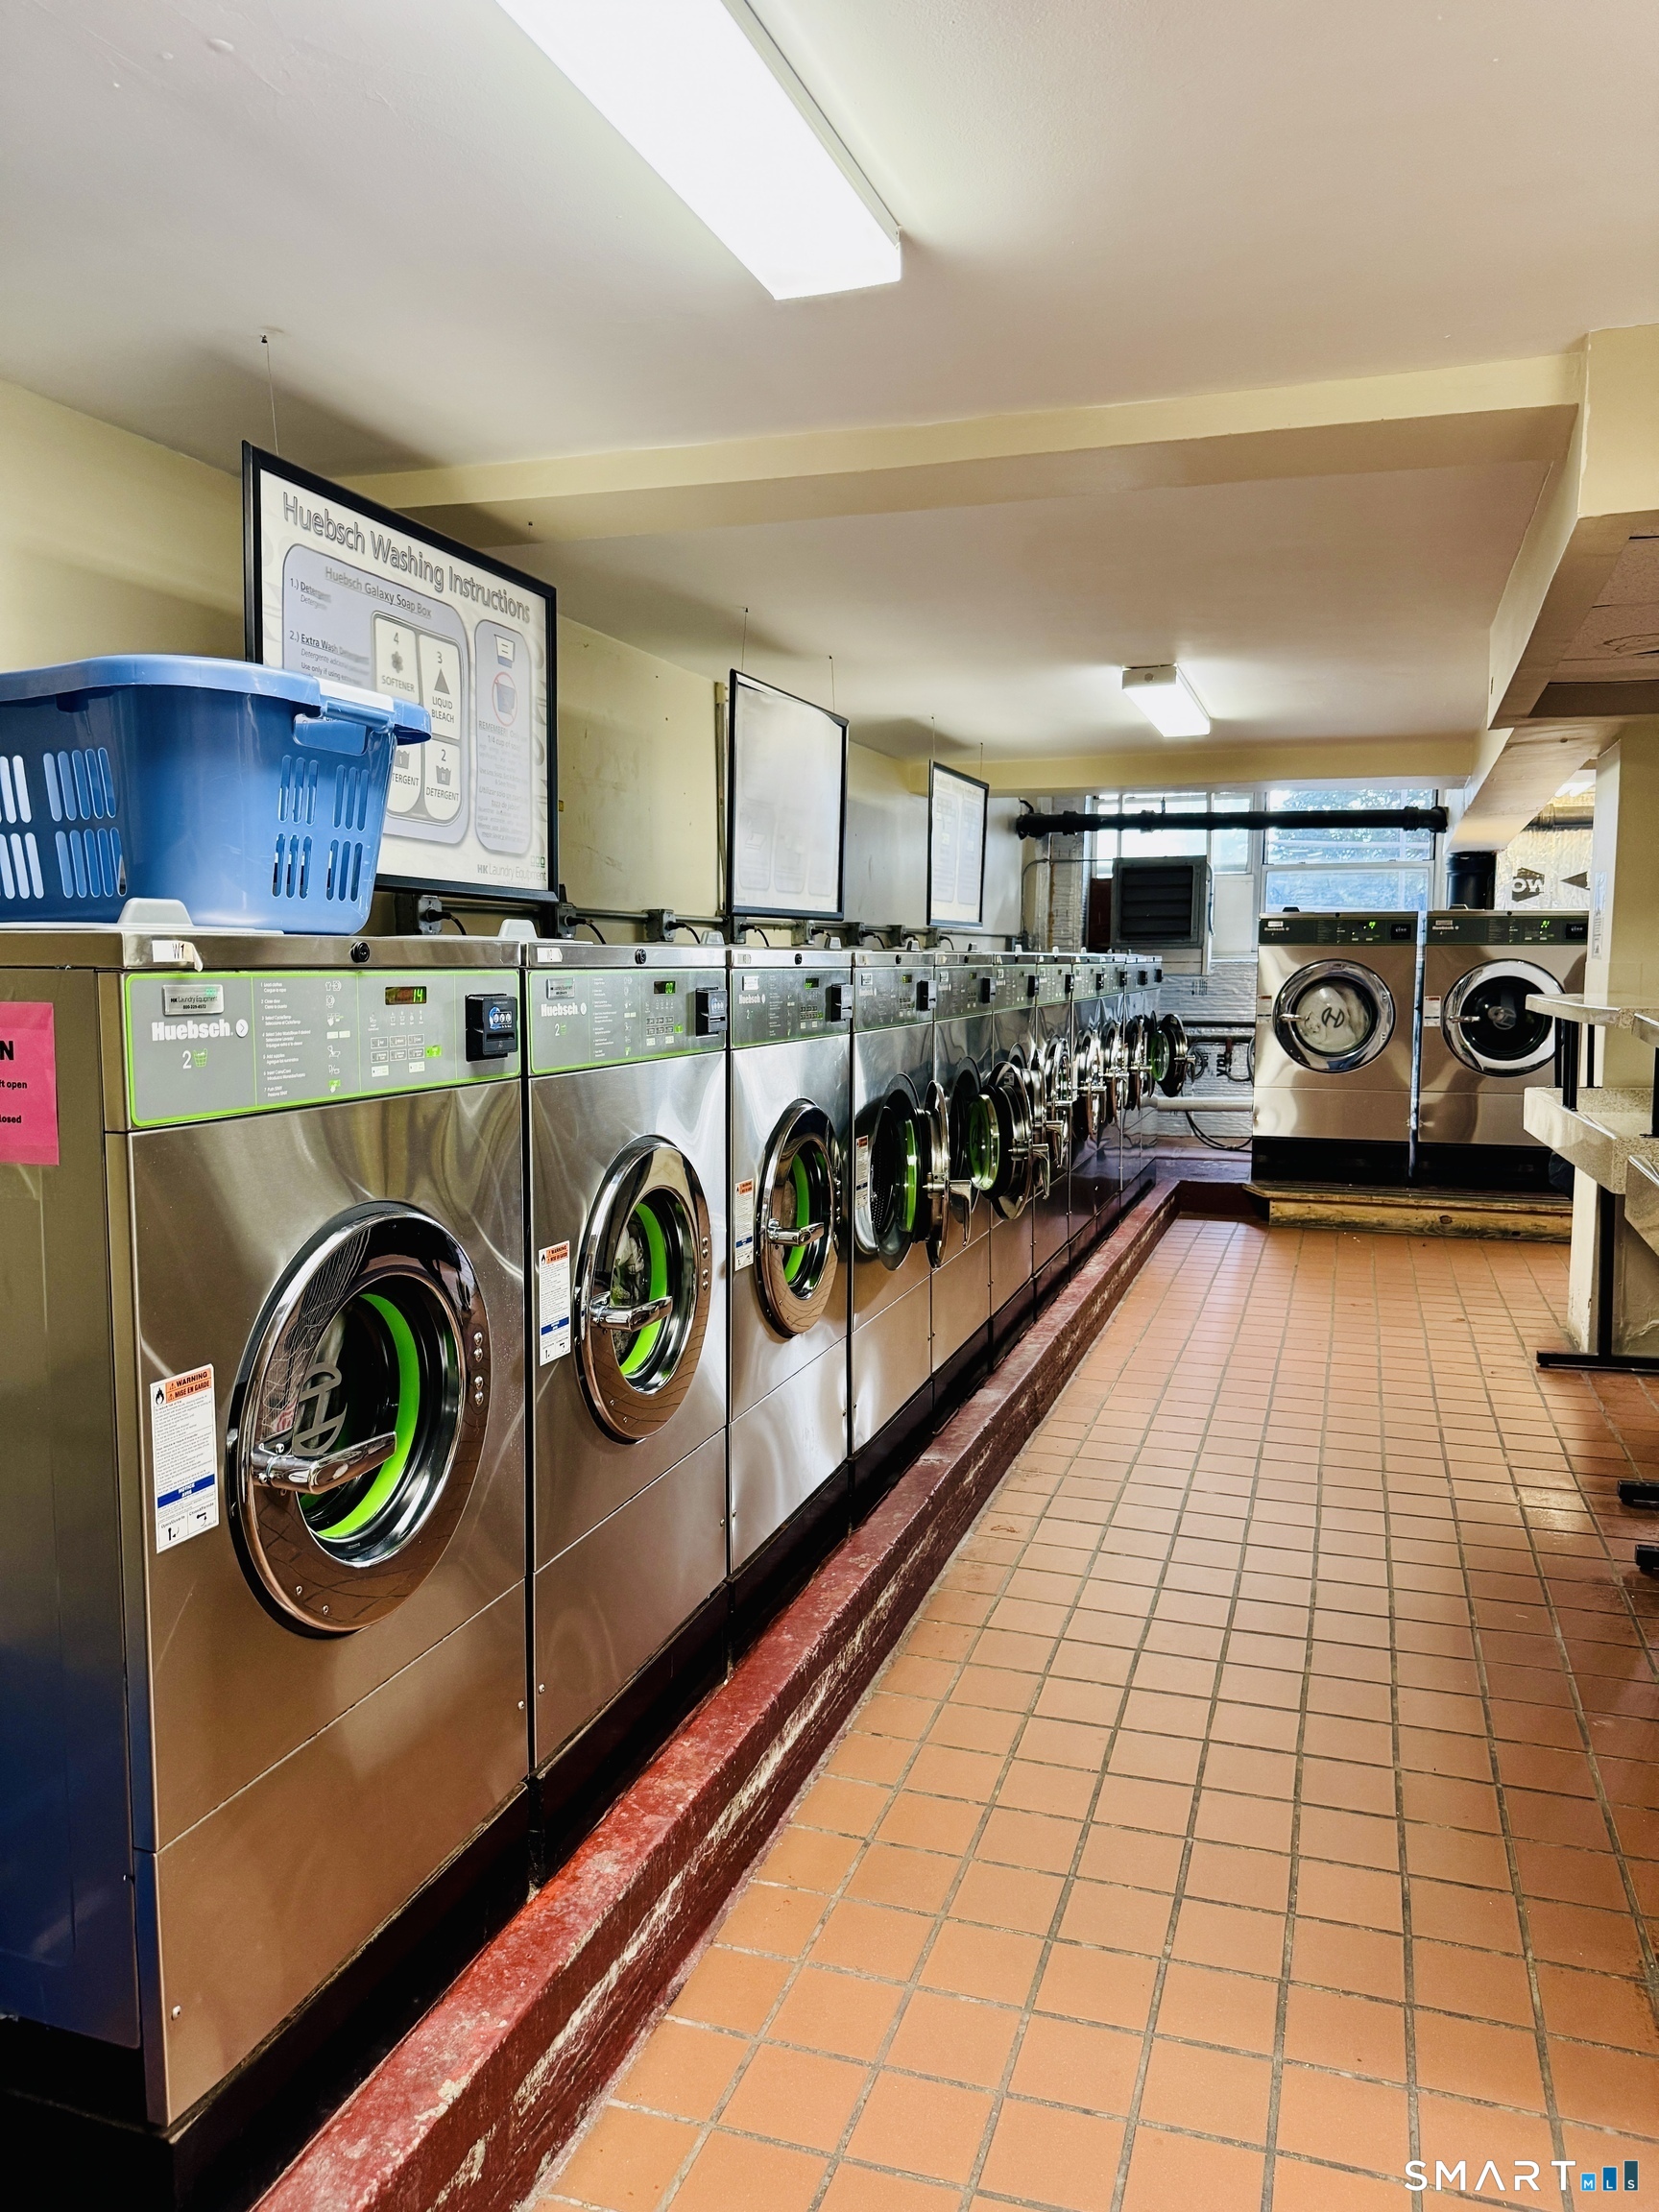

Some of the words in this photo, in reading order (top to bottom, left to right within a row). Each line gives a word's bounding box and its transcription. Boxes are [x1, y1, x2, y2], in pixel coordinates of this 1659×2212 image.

[283, 491, 366, 555] Huebsch
[370, 530, 445, 593] Washing
[448, 565, 530, 624] Instructions
[325, 565, 362, 590] Huebsch
[364, 582, 395, 605] Galaxy
[396, 593, 415, 613] Soap
[417, 603, 432, 619] Box
[301, 634, 320, 648] Extra
[321, 639, 339, 655] Wash
[394, 632, 399, 644] 4
[437, 651, 443, 663] 3
[301, 661, 311, 671] Use
[311, 665, 323, 675] only
[381, 675, 415, 693] SOFTENER
[432, 696, 453, 710] LIQUID
[431, 709, 454, 724] BLEACH
[441, 749, 446, 761] 2
[392, 772, 419, 786] TERGENT
[426, 786, 459, 802] DETERGENT
[477, 863, 489, 874] HK
[173, 943, 184, 959] W1
[412, 988, 423, 1003] 14
[541, 1002, 579, 1017] Huebsch
[152, 1019, 230, 1041] Huebsch
[555, 1023, 560, 1036] 2
[182, 1050, 192, 1070] 2
[6, 1081, 28, 1091] open
[0, 1115, 22, 1123] losed
[176, 1372, 207, 1387] WARNING
[175, 1389, 186, 1398] MISE
[195, 1381, 210, 1391] GARDE
